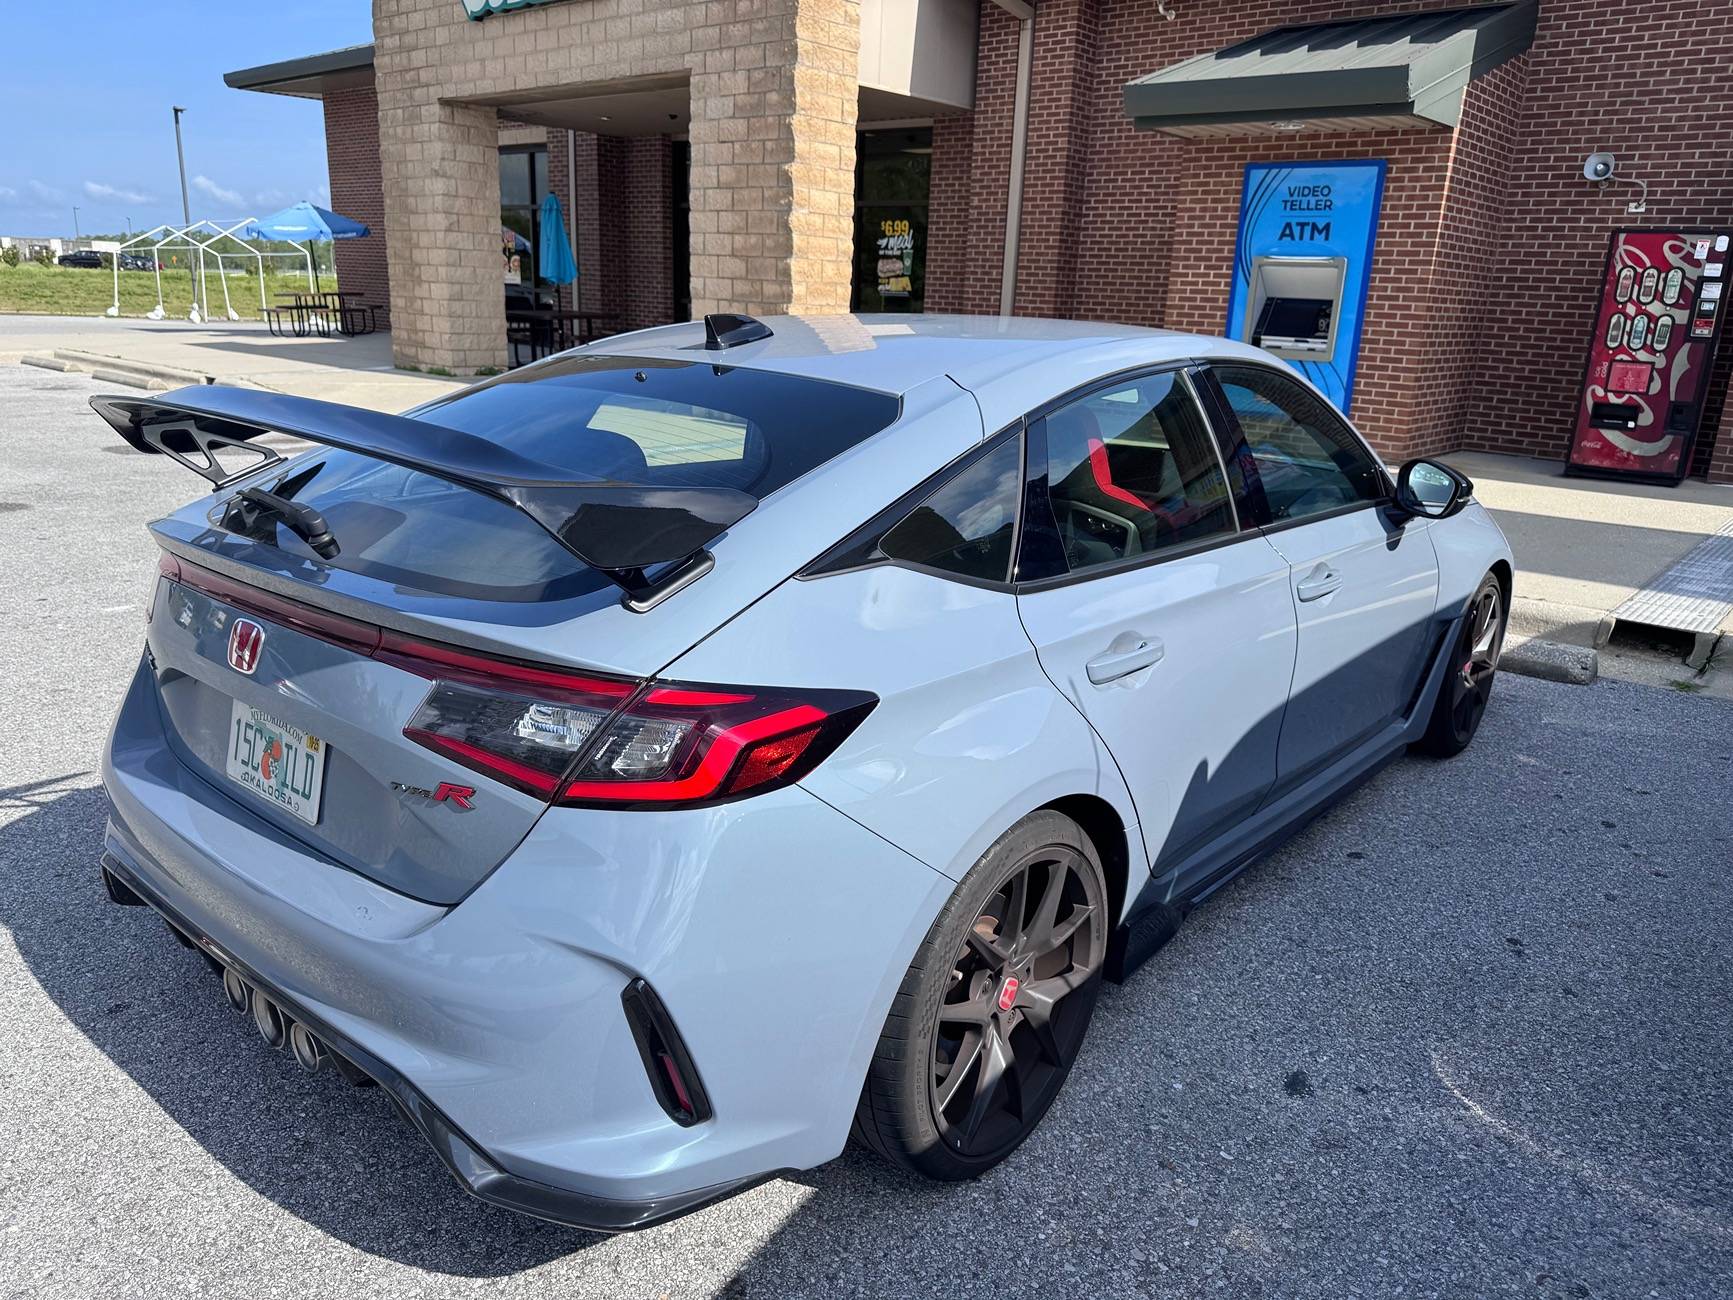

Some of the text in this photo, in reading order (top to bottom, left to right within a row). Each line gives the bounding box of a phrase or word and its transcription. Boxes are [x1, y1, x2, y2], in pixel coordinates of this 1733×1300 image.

[1288, 185, 1332, 198] VIDEO
[1282, 199, 1333, 211] TELLER
[881, 220, 910, 236] $6.99
[1278, 221, 1332, 241] ATM
[250, 709, 303, 745] MYFLORIDA.COM
[281, 742, 315, 801] ILD
[243, 772, 296, 807] OKALOOSA
[391, 781, 477, 810] TYPE R
